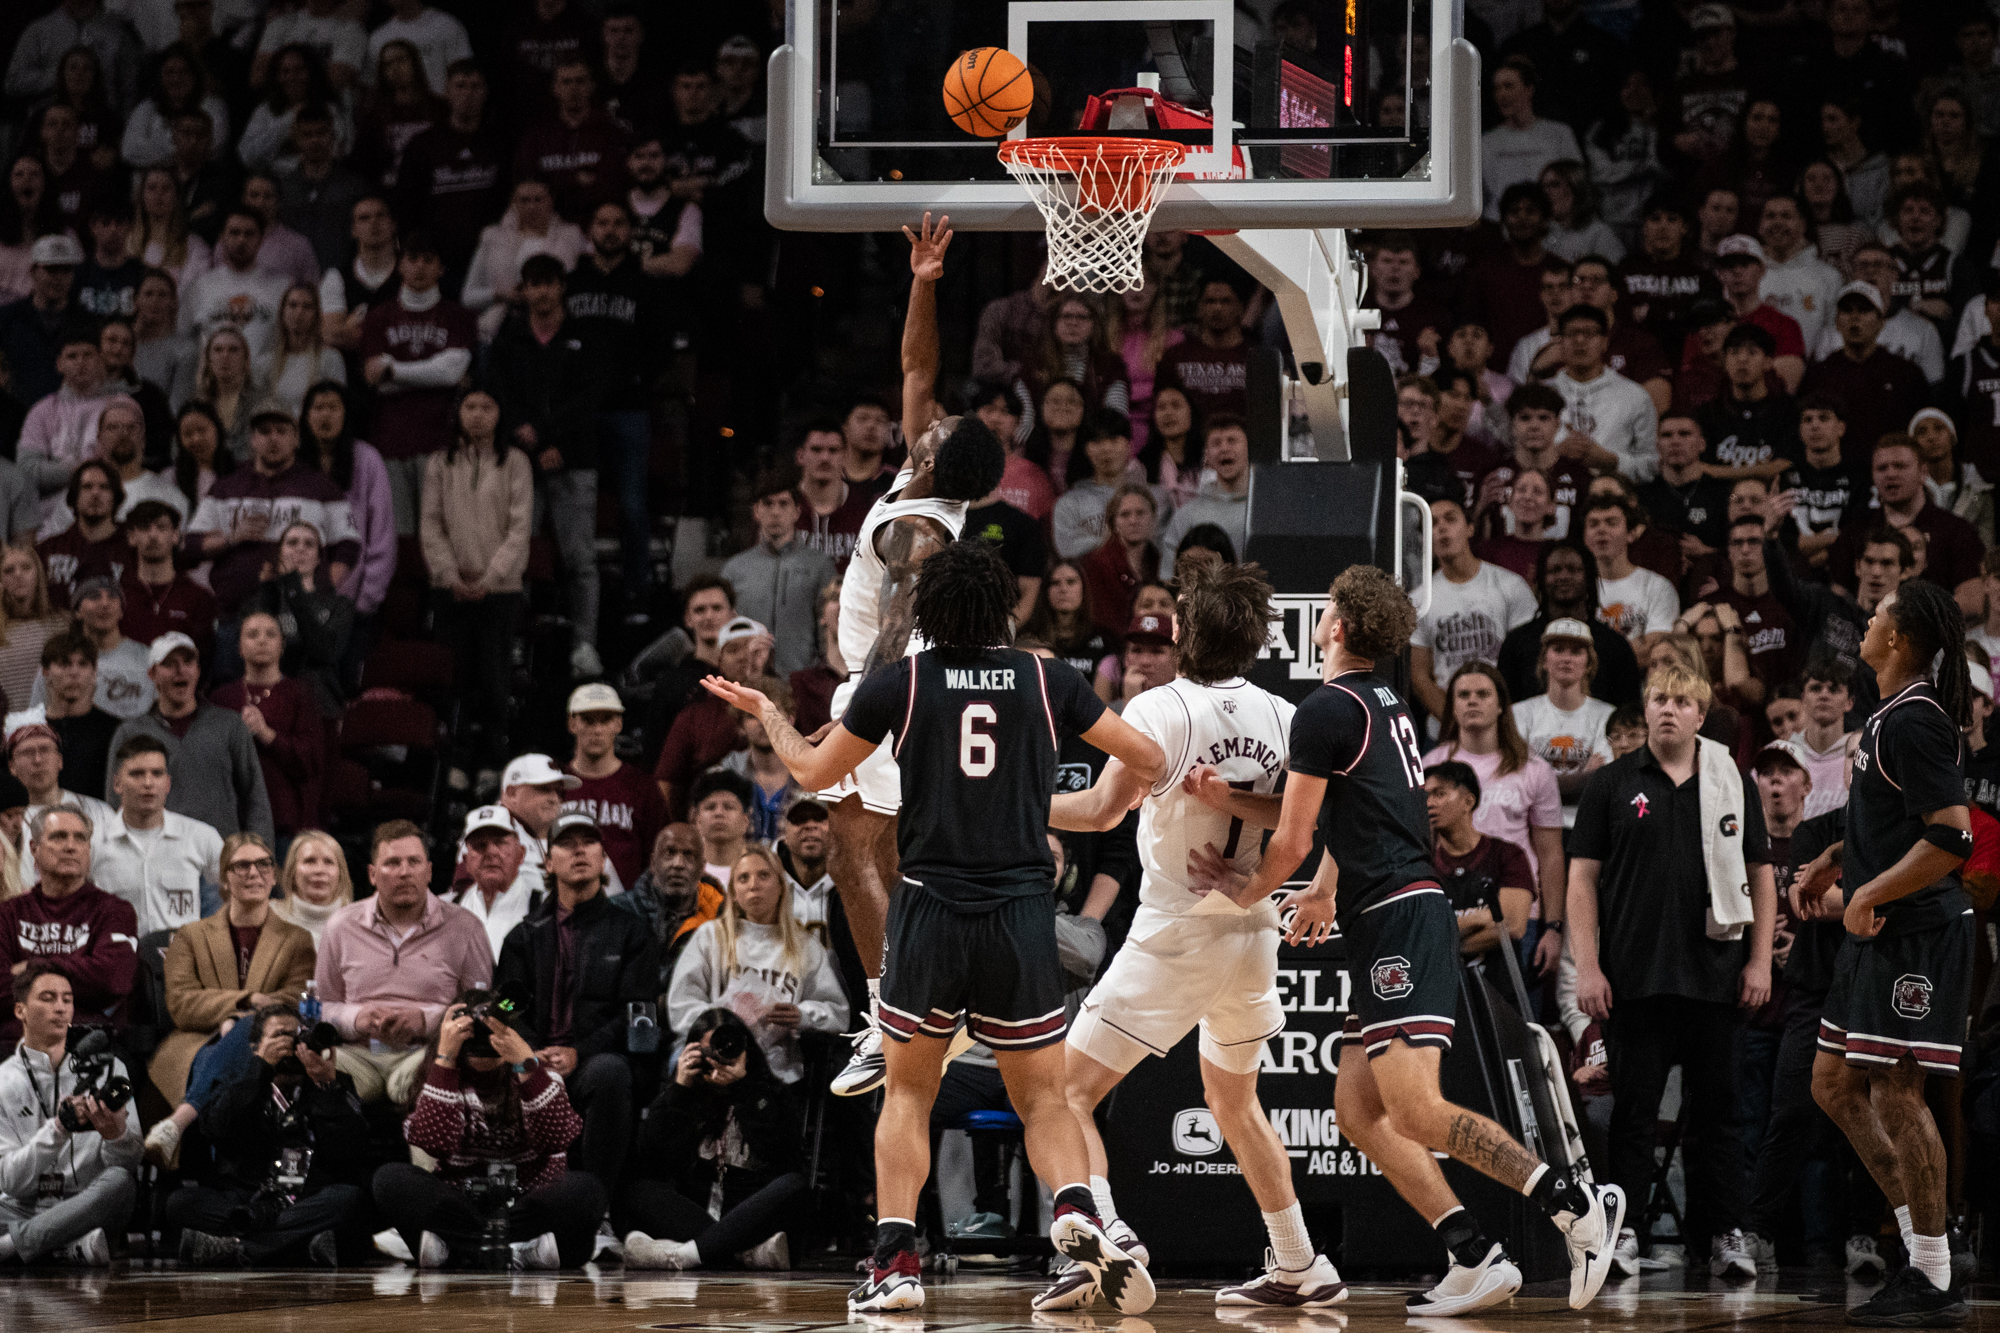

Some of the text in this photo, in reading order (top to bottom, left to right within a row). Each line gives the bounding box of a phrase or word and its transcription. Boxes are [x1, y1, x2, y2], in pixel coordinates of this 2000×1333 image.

[945, 667, 1016, 690] WALKER
[959, 701, 998, 778] 6
[1189, 737, 1282, 780] EMENCE
[1388, 712, 1426, 793] 13
[1270, 1109, 1340, 1148] KING
[1307, 1151, 1338, 1176] AG
